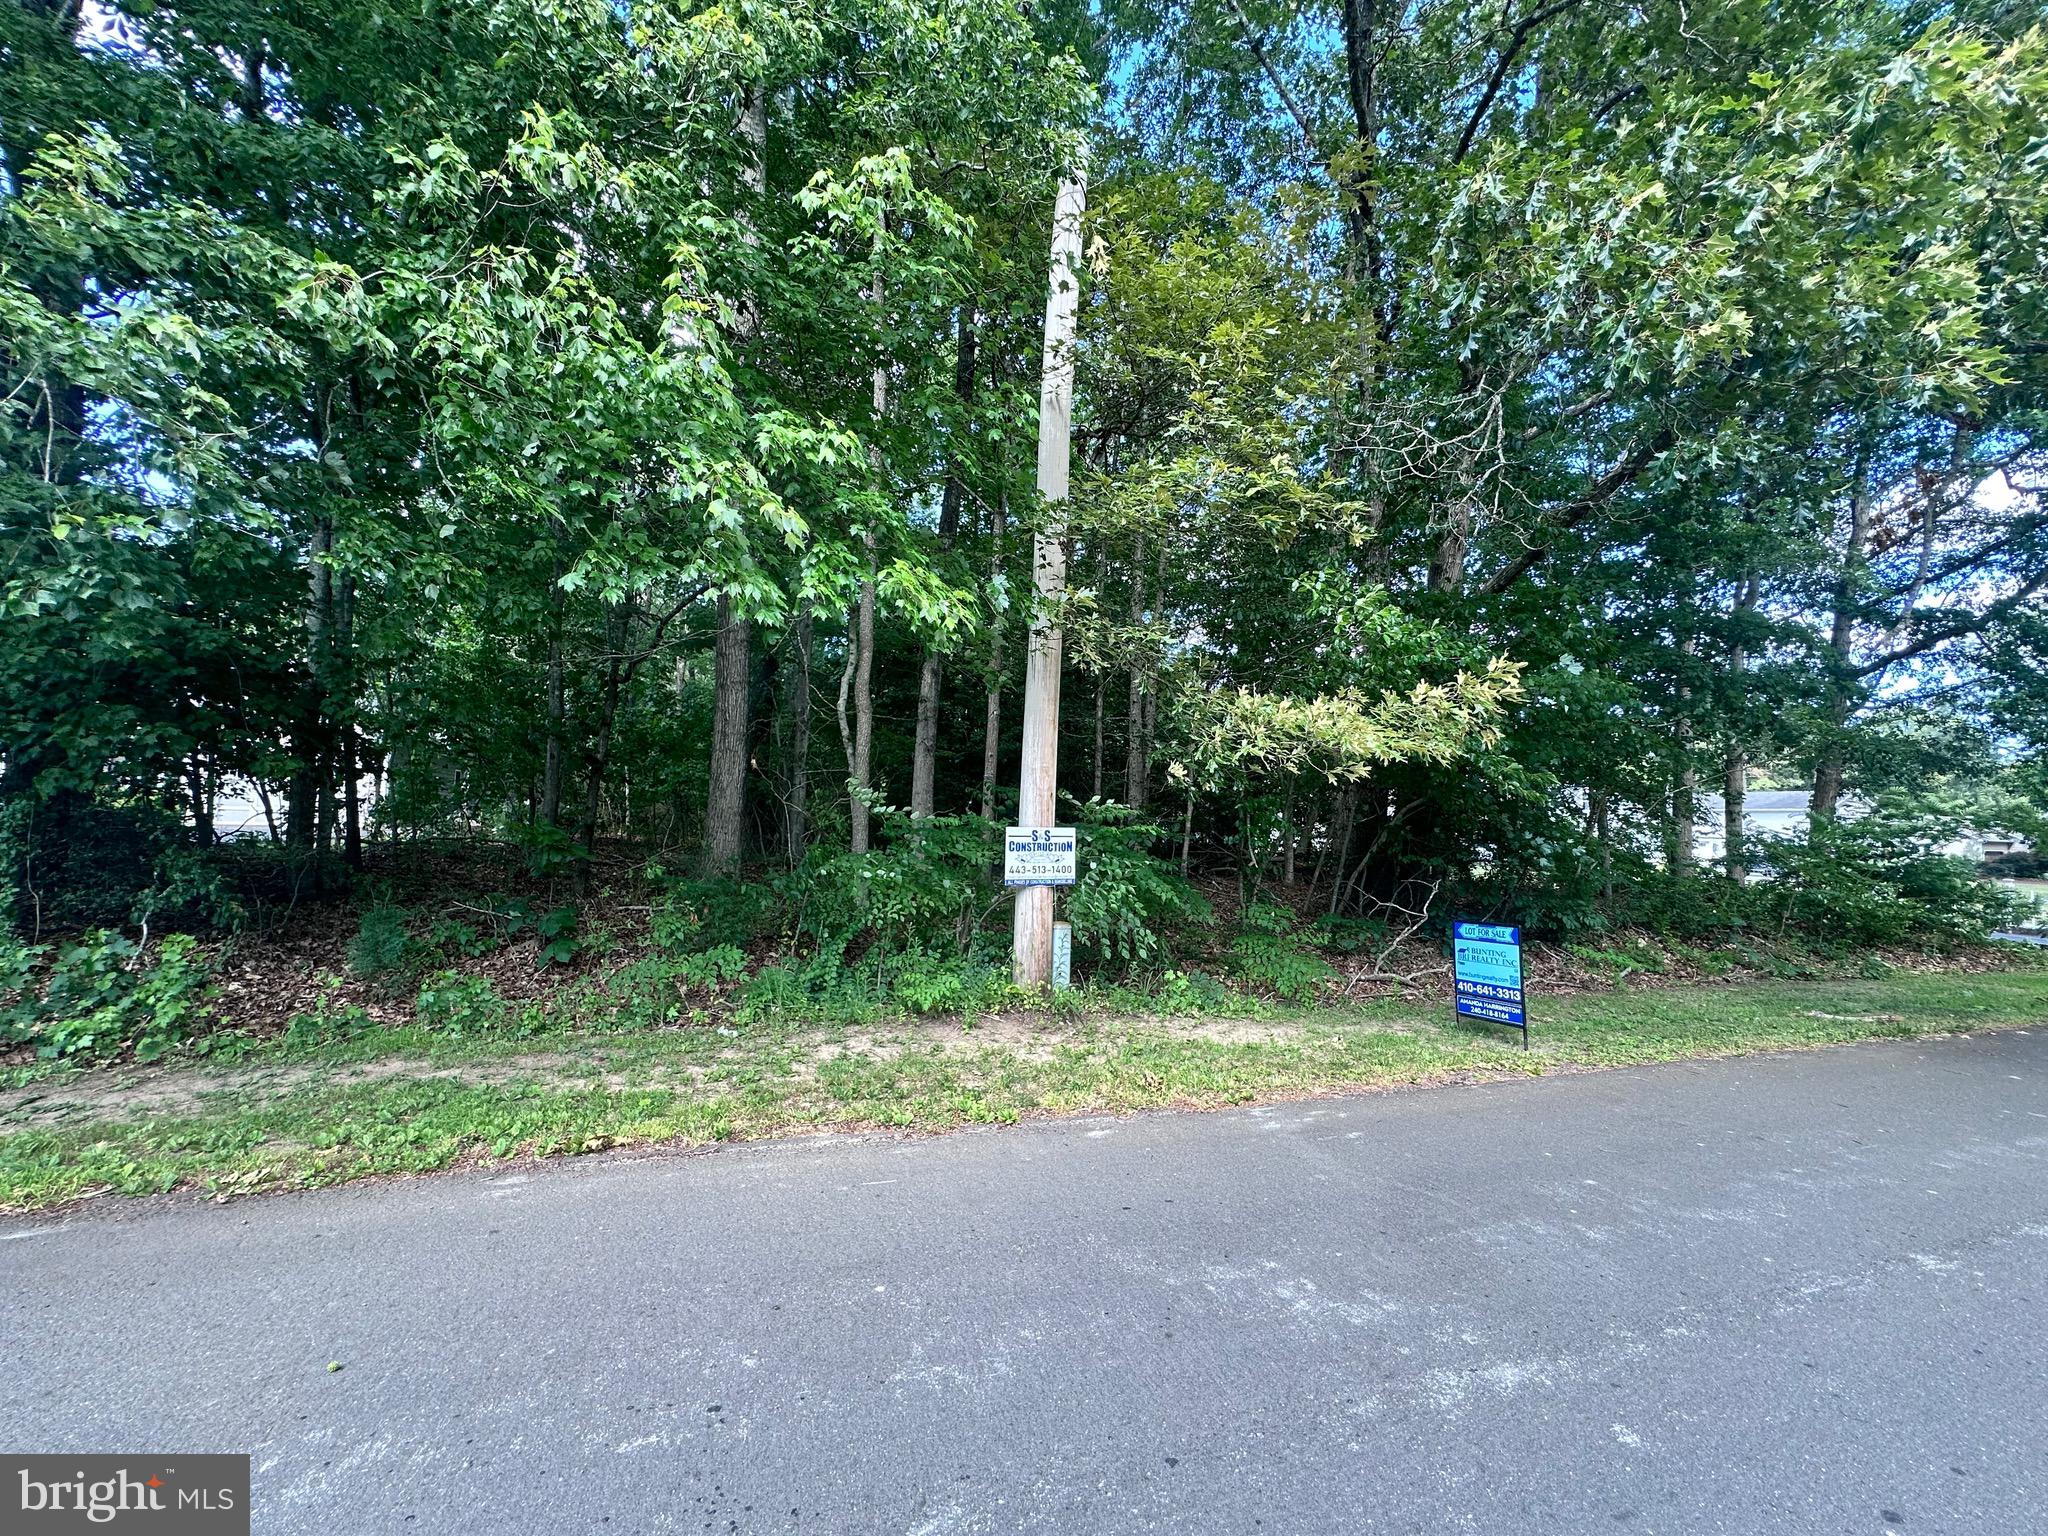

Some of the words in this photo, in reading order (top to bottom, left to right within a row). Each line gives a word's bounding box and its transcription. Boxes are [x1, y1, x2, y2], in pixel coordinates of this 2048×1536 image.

[1031, 829, 1039, 842] S
[1044, 829, 1051, 842] S
[1009, 841, 1073, 852] CONSTRUCTION
[1009, 865, 1072, 874] 443-513-1400
[1464, 927, 1476, 936] LOT
[1477, 928, 1490, 937] FOR
[1491, 930, 1507, 939] SALE
[1471, 947, 1507, 958] BUNTING
[1471, 954, 1500, 965] REALTY
[1502, 959, 1518, 968] INC
[1457, 981, 1521, 1001] 410-641-3313
[1460, 998, 1483, 1007] AMANDA
[1484, 1002, 1521, 1014] HARRINGTON
